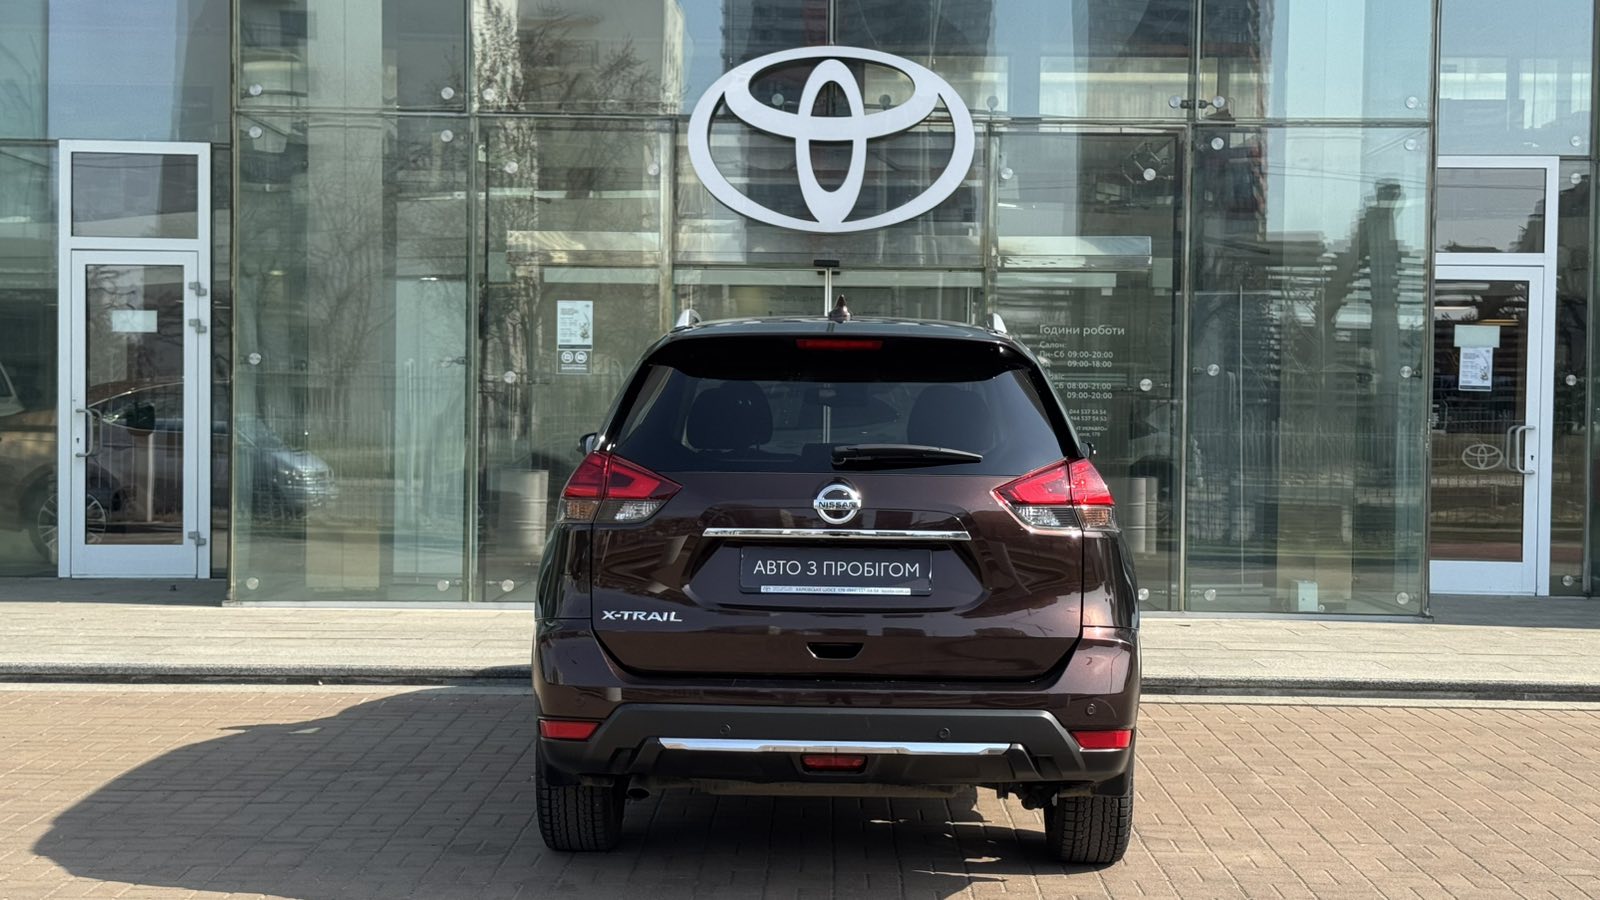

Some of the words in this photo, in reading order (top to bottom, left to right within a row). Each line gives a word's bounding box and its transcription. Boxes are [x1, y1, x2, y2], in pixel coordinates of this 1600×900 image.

[1040, 324, 1080, 336] Години
[1083, 324, 1125, 337] роботи
[1040, 350, 1065, 358] Пн-Сб
[1067, 350, 1114, 359] 09:00-20:00
[1067, 360, 1113, 368] 09:00-18:00
[1066, 382, 1112, 390] 08:00-21:00
[1066, 391, 1113, 399] 09:00-20:00
[818, 501, 857, 509] NISSAN
[753, 560, 801, 575] АВТО
[806, 561, 817, 575] З
[823, 561, 920, 577] ПРОБІГОМ
[601, 610, 683, 622] X-TRAIL
